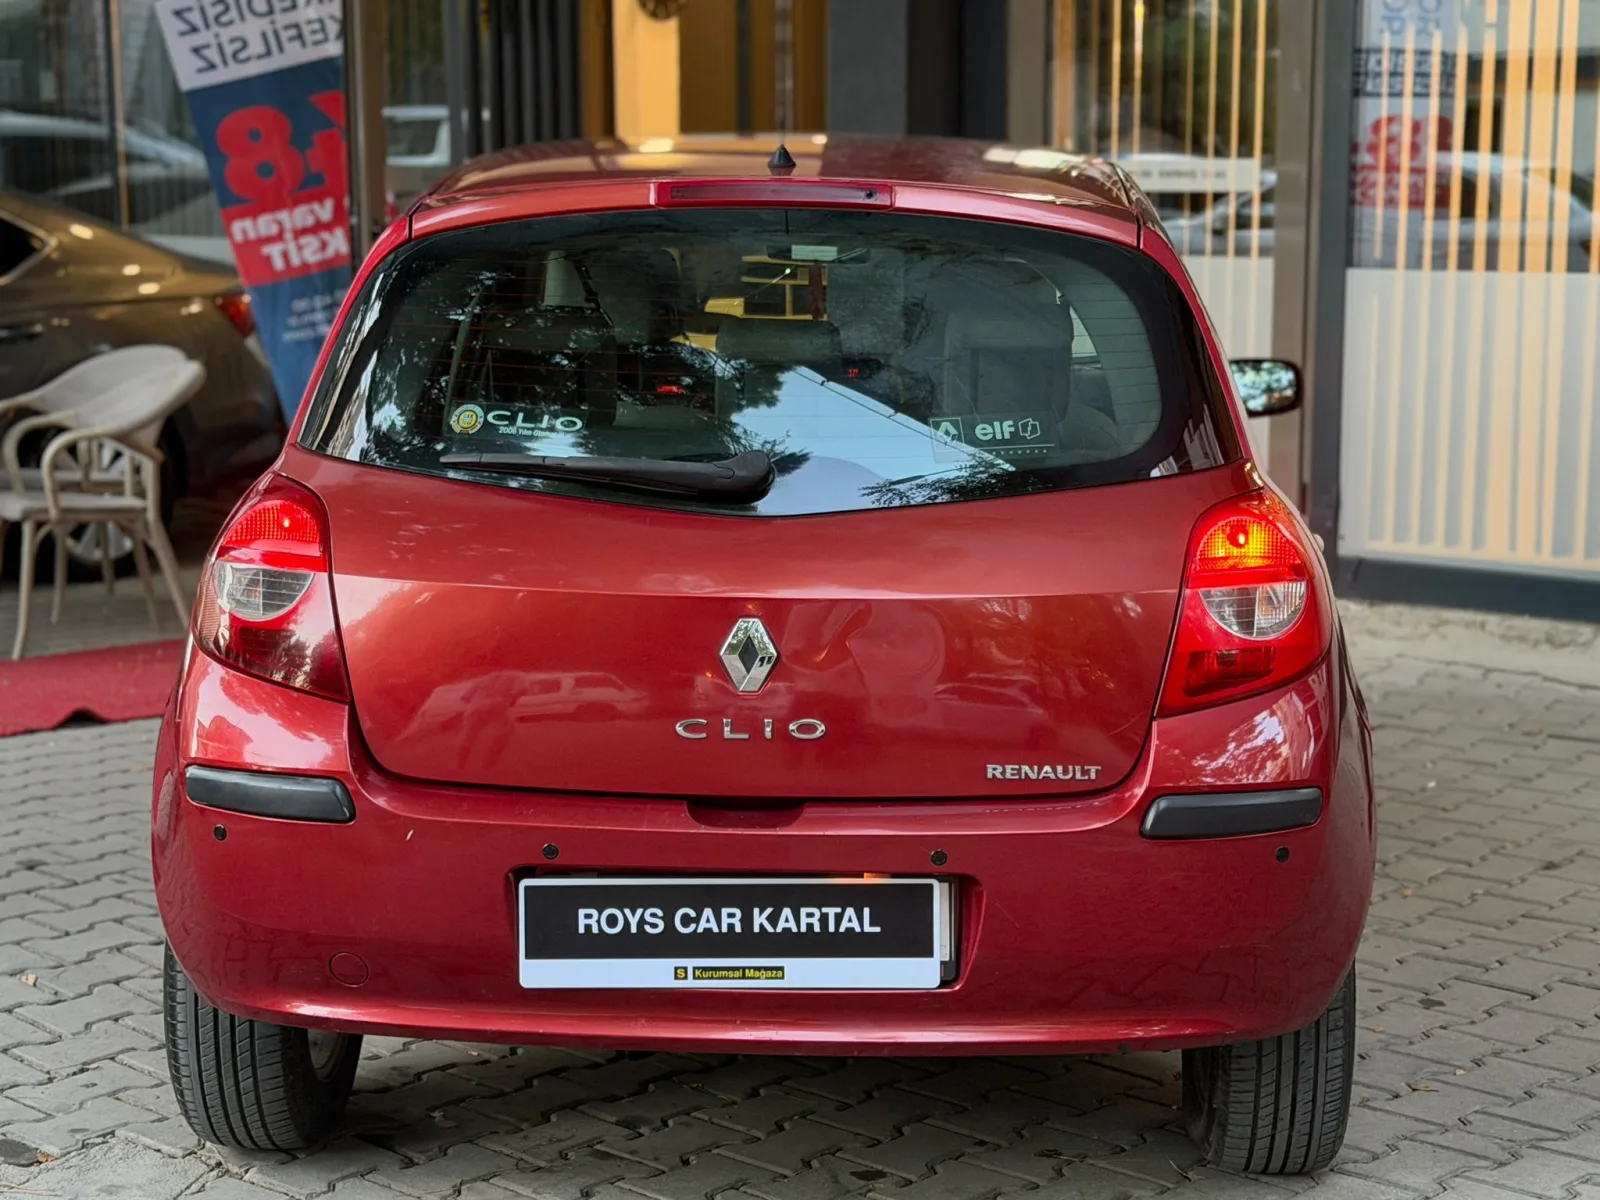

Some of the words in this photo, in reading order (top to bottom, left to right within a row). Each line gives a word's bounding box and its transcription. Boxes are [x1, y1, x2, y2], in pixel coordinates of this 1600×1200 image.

[486, 410, 583, 432] CLIO
[975, 420, 1015, 440] elf
[675, 718, 826, 740] CLIO
[986, 763, 1101, 781] RENAULT
[577, 907, 665, 935] ROYS
[674, 907, 742, 934] CAR
[752, 906, 881, 933] KARTAL
[695, 968, 743, 978] Kurumsal
[745, 968, 783, 979] Mağaza
